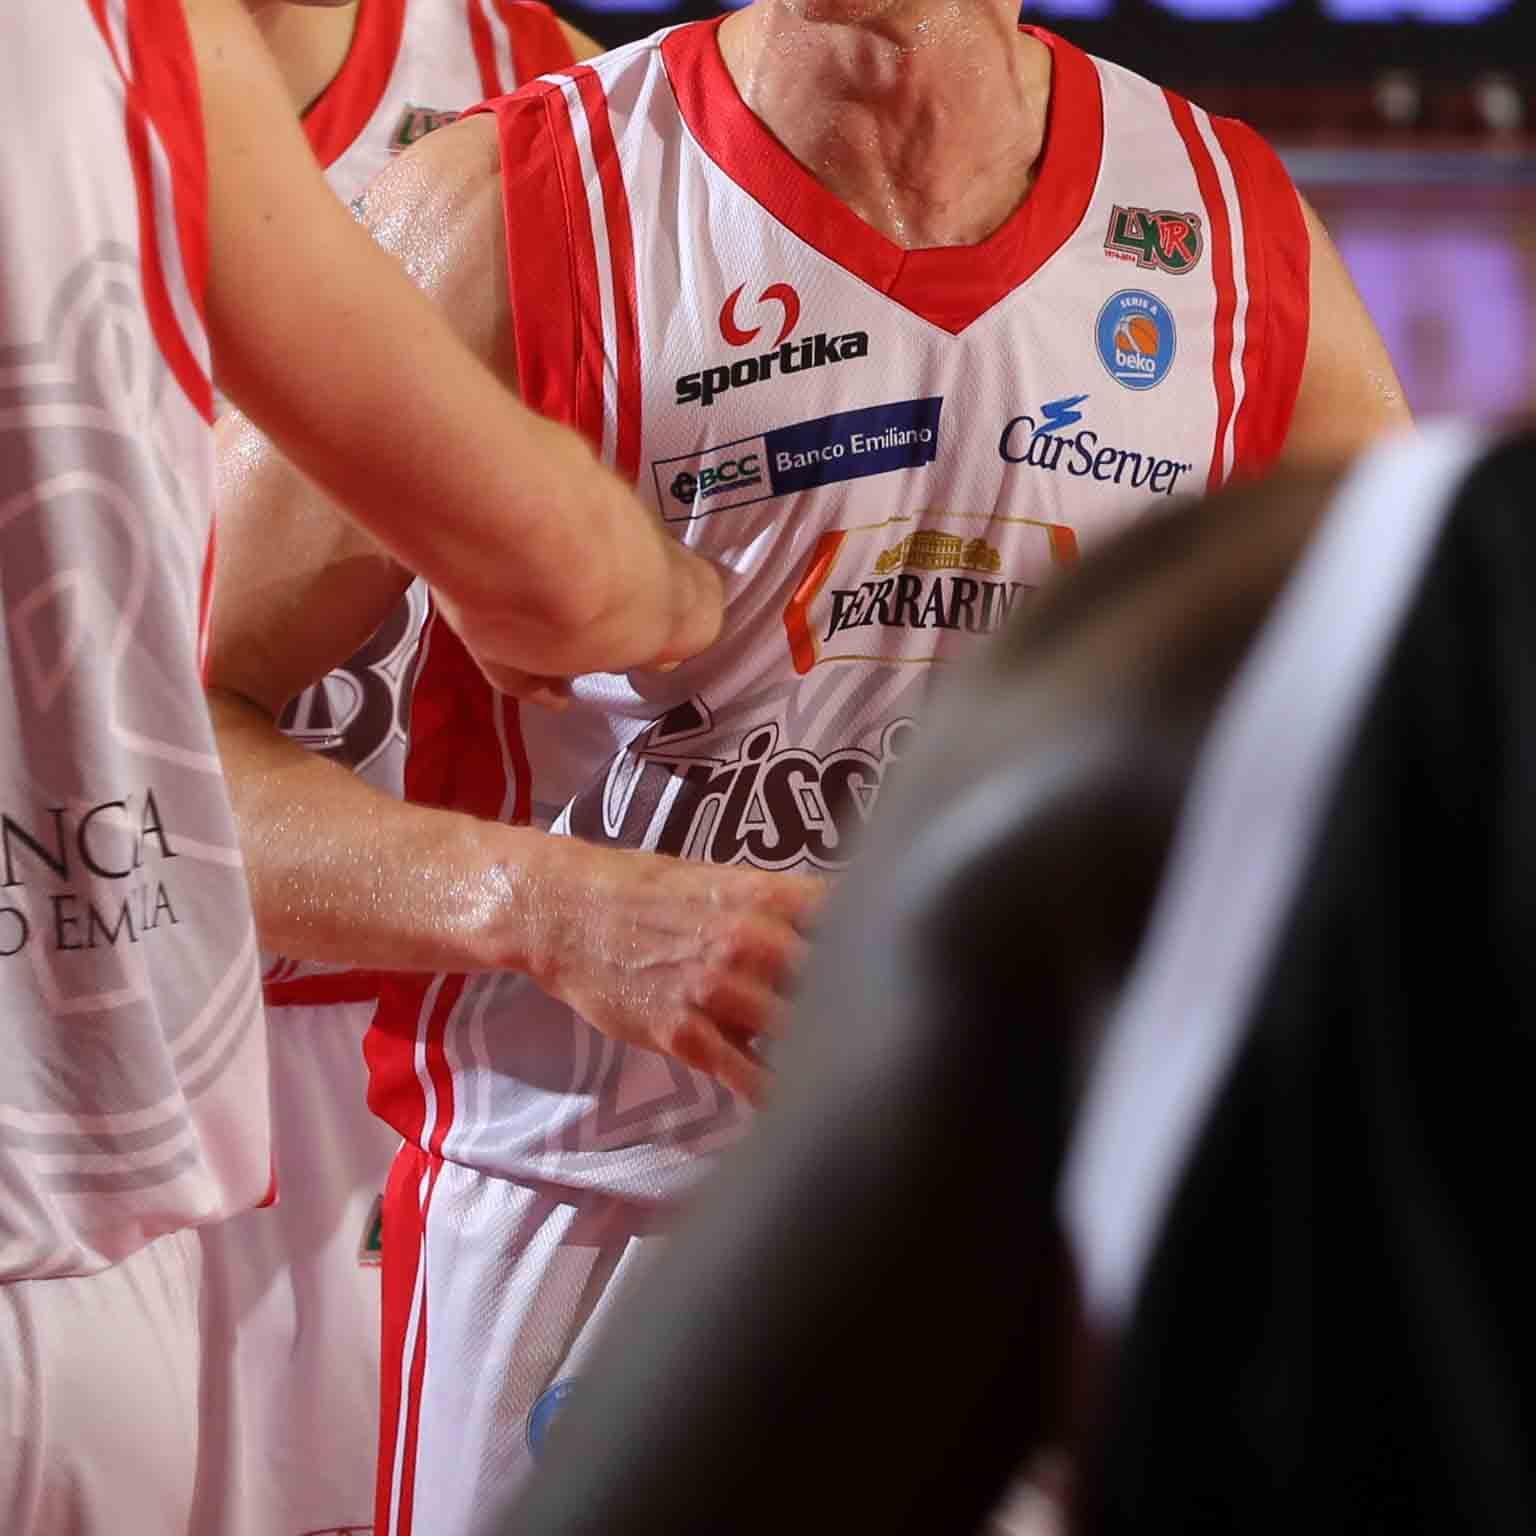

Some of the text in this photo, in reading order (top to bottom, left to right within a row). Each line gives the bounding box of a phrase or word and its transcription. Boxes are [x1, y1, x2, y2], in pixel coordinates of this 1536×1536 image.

[1120, 296, 1148, 309] SERIE
[675, 331, 868, 406] sportika
[1116, 349, 1156, 372] beko
[699, 455, 760, 489] BCC
[775, 443, 845, 473] Banco
[850, 426, 933, 455] Emiliano
[823, 574, 1040, 642] FERRARIN
